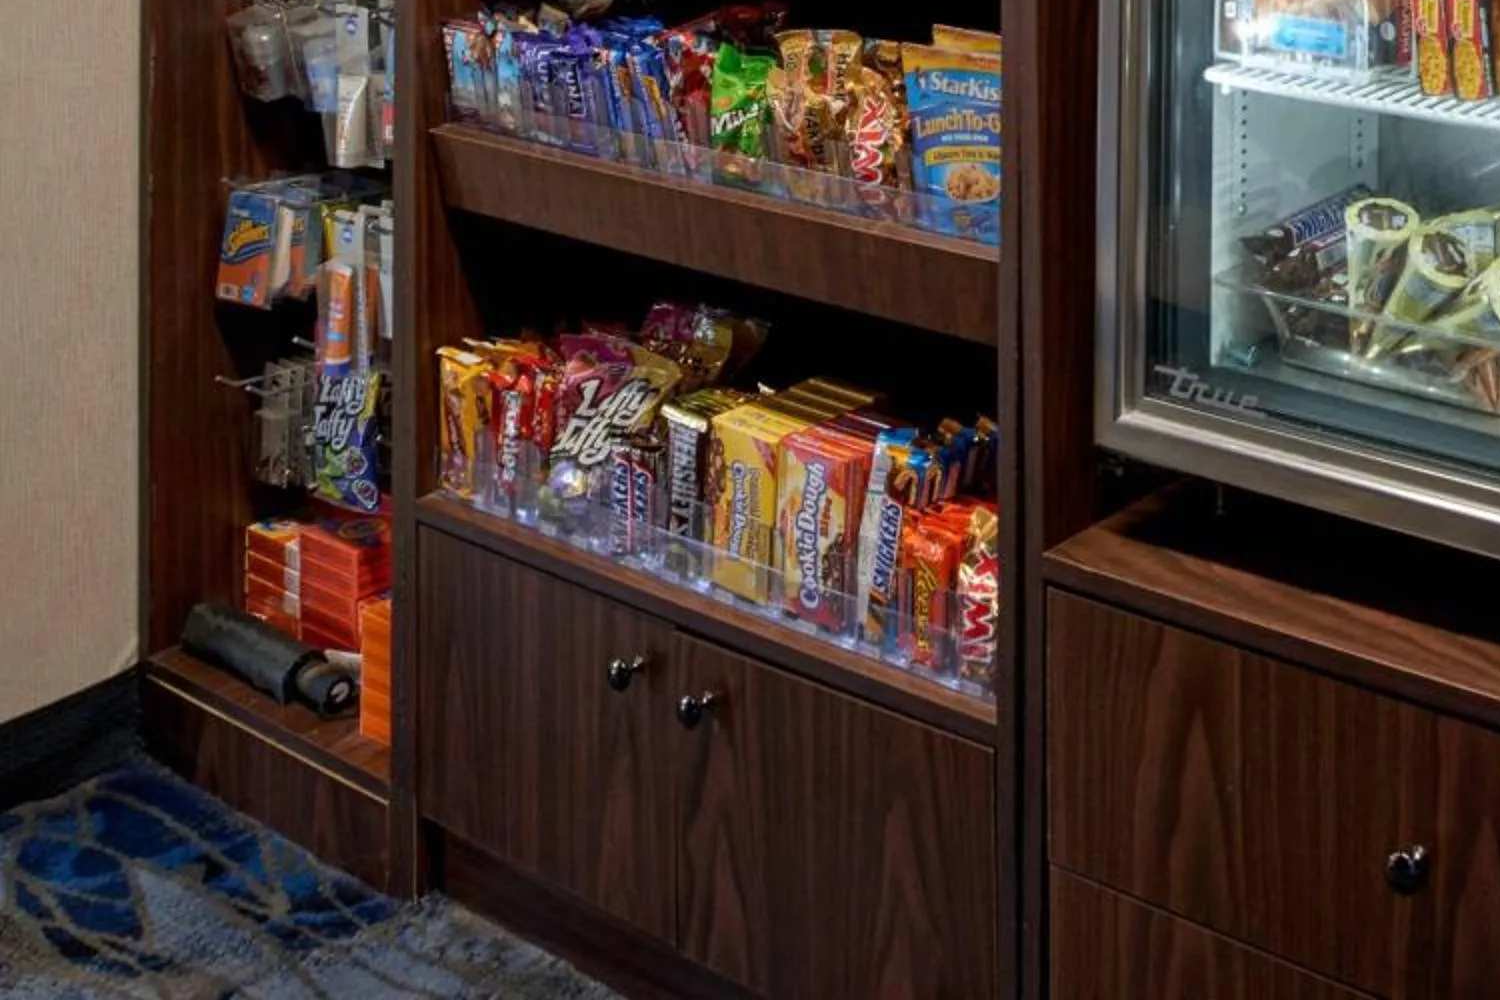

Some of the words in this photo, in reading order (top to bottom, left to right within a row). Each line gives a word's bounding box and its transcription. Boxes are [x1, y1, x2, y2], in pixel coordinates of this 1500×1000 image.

[930, 71, 1002, 102] StarKis
[313, 404, 356, 450] Taffy
[575, 378, 658, 428] Laffy
[550, 418, 612, 466] Taffy
[797, 461, 827, 533] Dough
